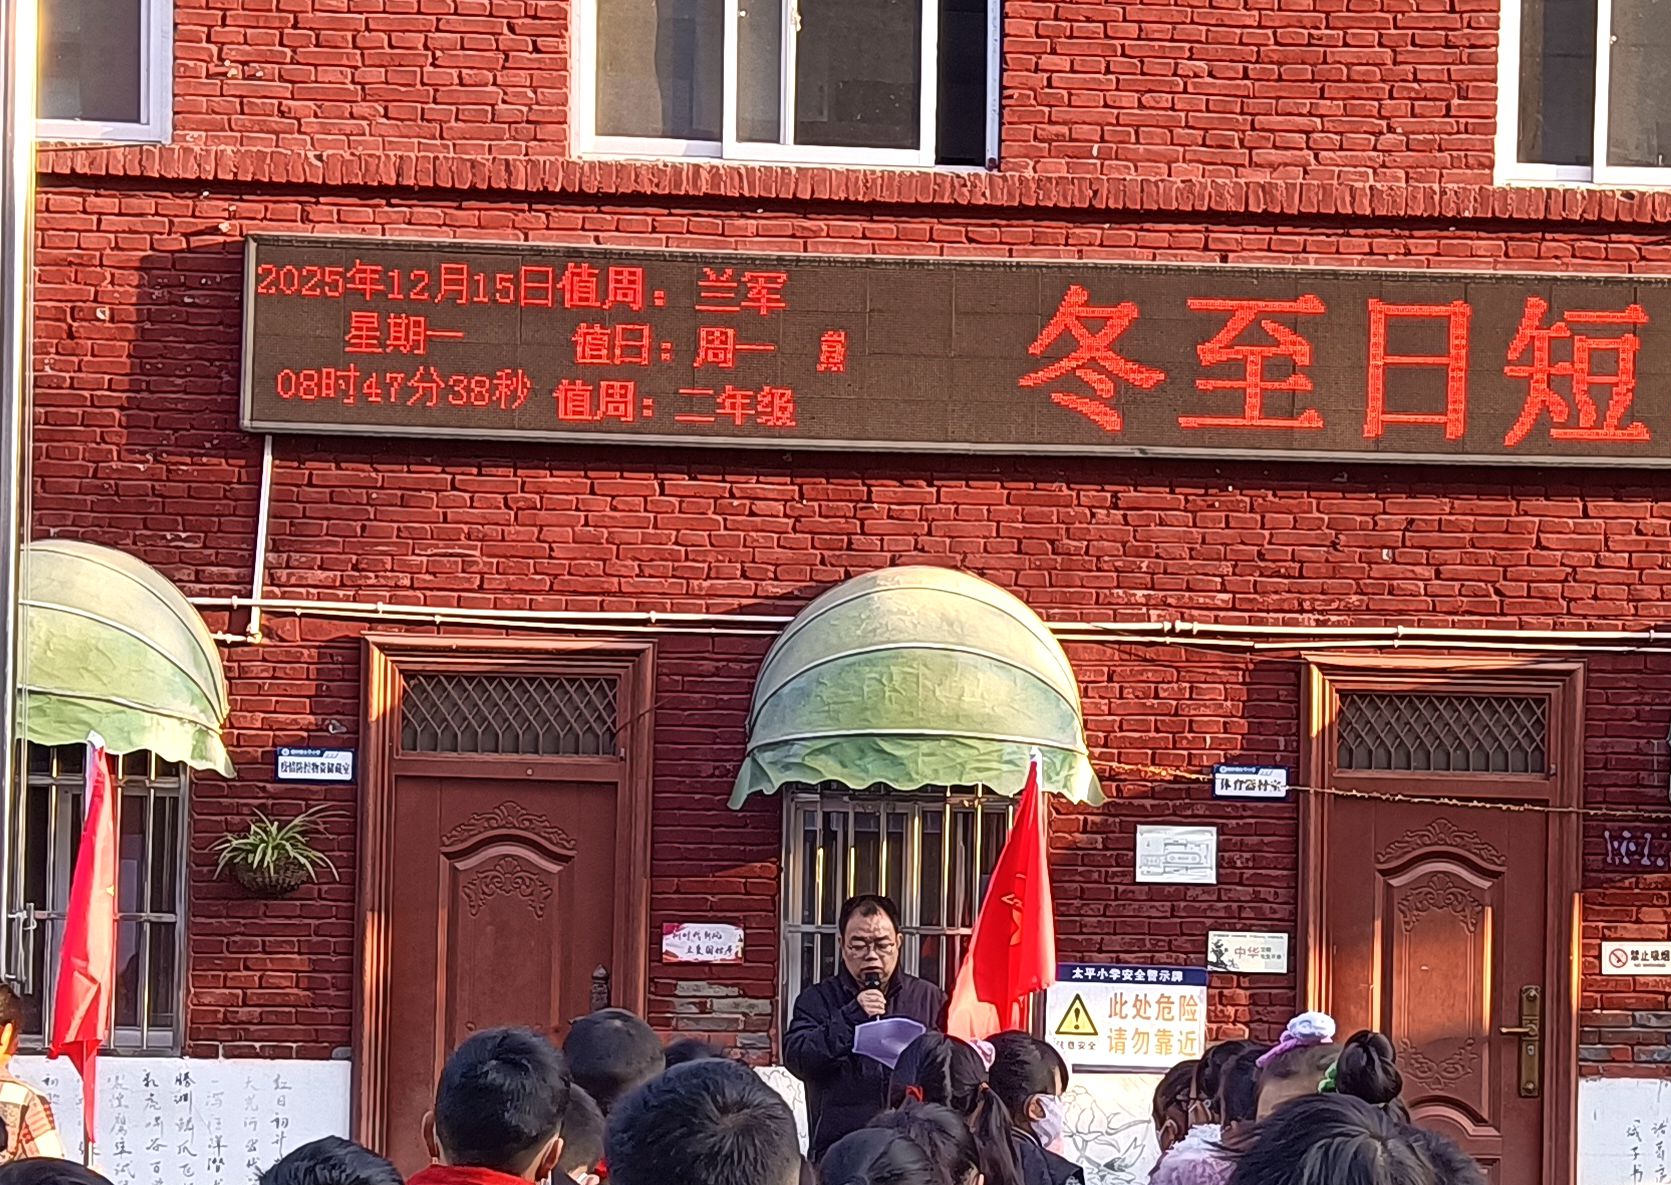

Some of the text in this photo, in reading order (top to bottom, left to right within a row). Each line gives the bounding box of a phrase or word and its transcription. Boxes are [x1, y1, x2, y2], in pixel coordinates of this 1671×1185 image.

[345, 311, 464, 355] 星期一
[277, 364, 531, 409] 08时47分38秒
[1234, 946, 1260, 959] 中华
[1631, 950, 1670, 961] 禁止吸烟
[1072, 967, 1184, 982] 太平小学安全警示牌
[1108, 992, 1198, 1022] 此处危险
[1107, 1027, 1197, 1057] 请勿靠近
[270, 1073, 292, 1163] 红日初升
